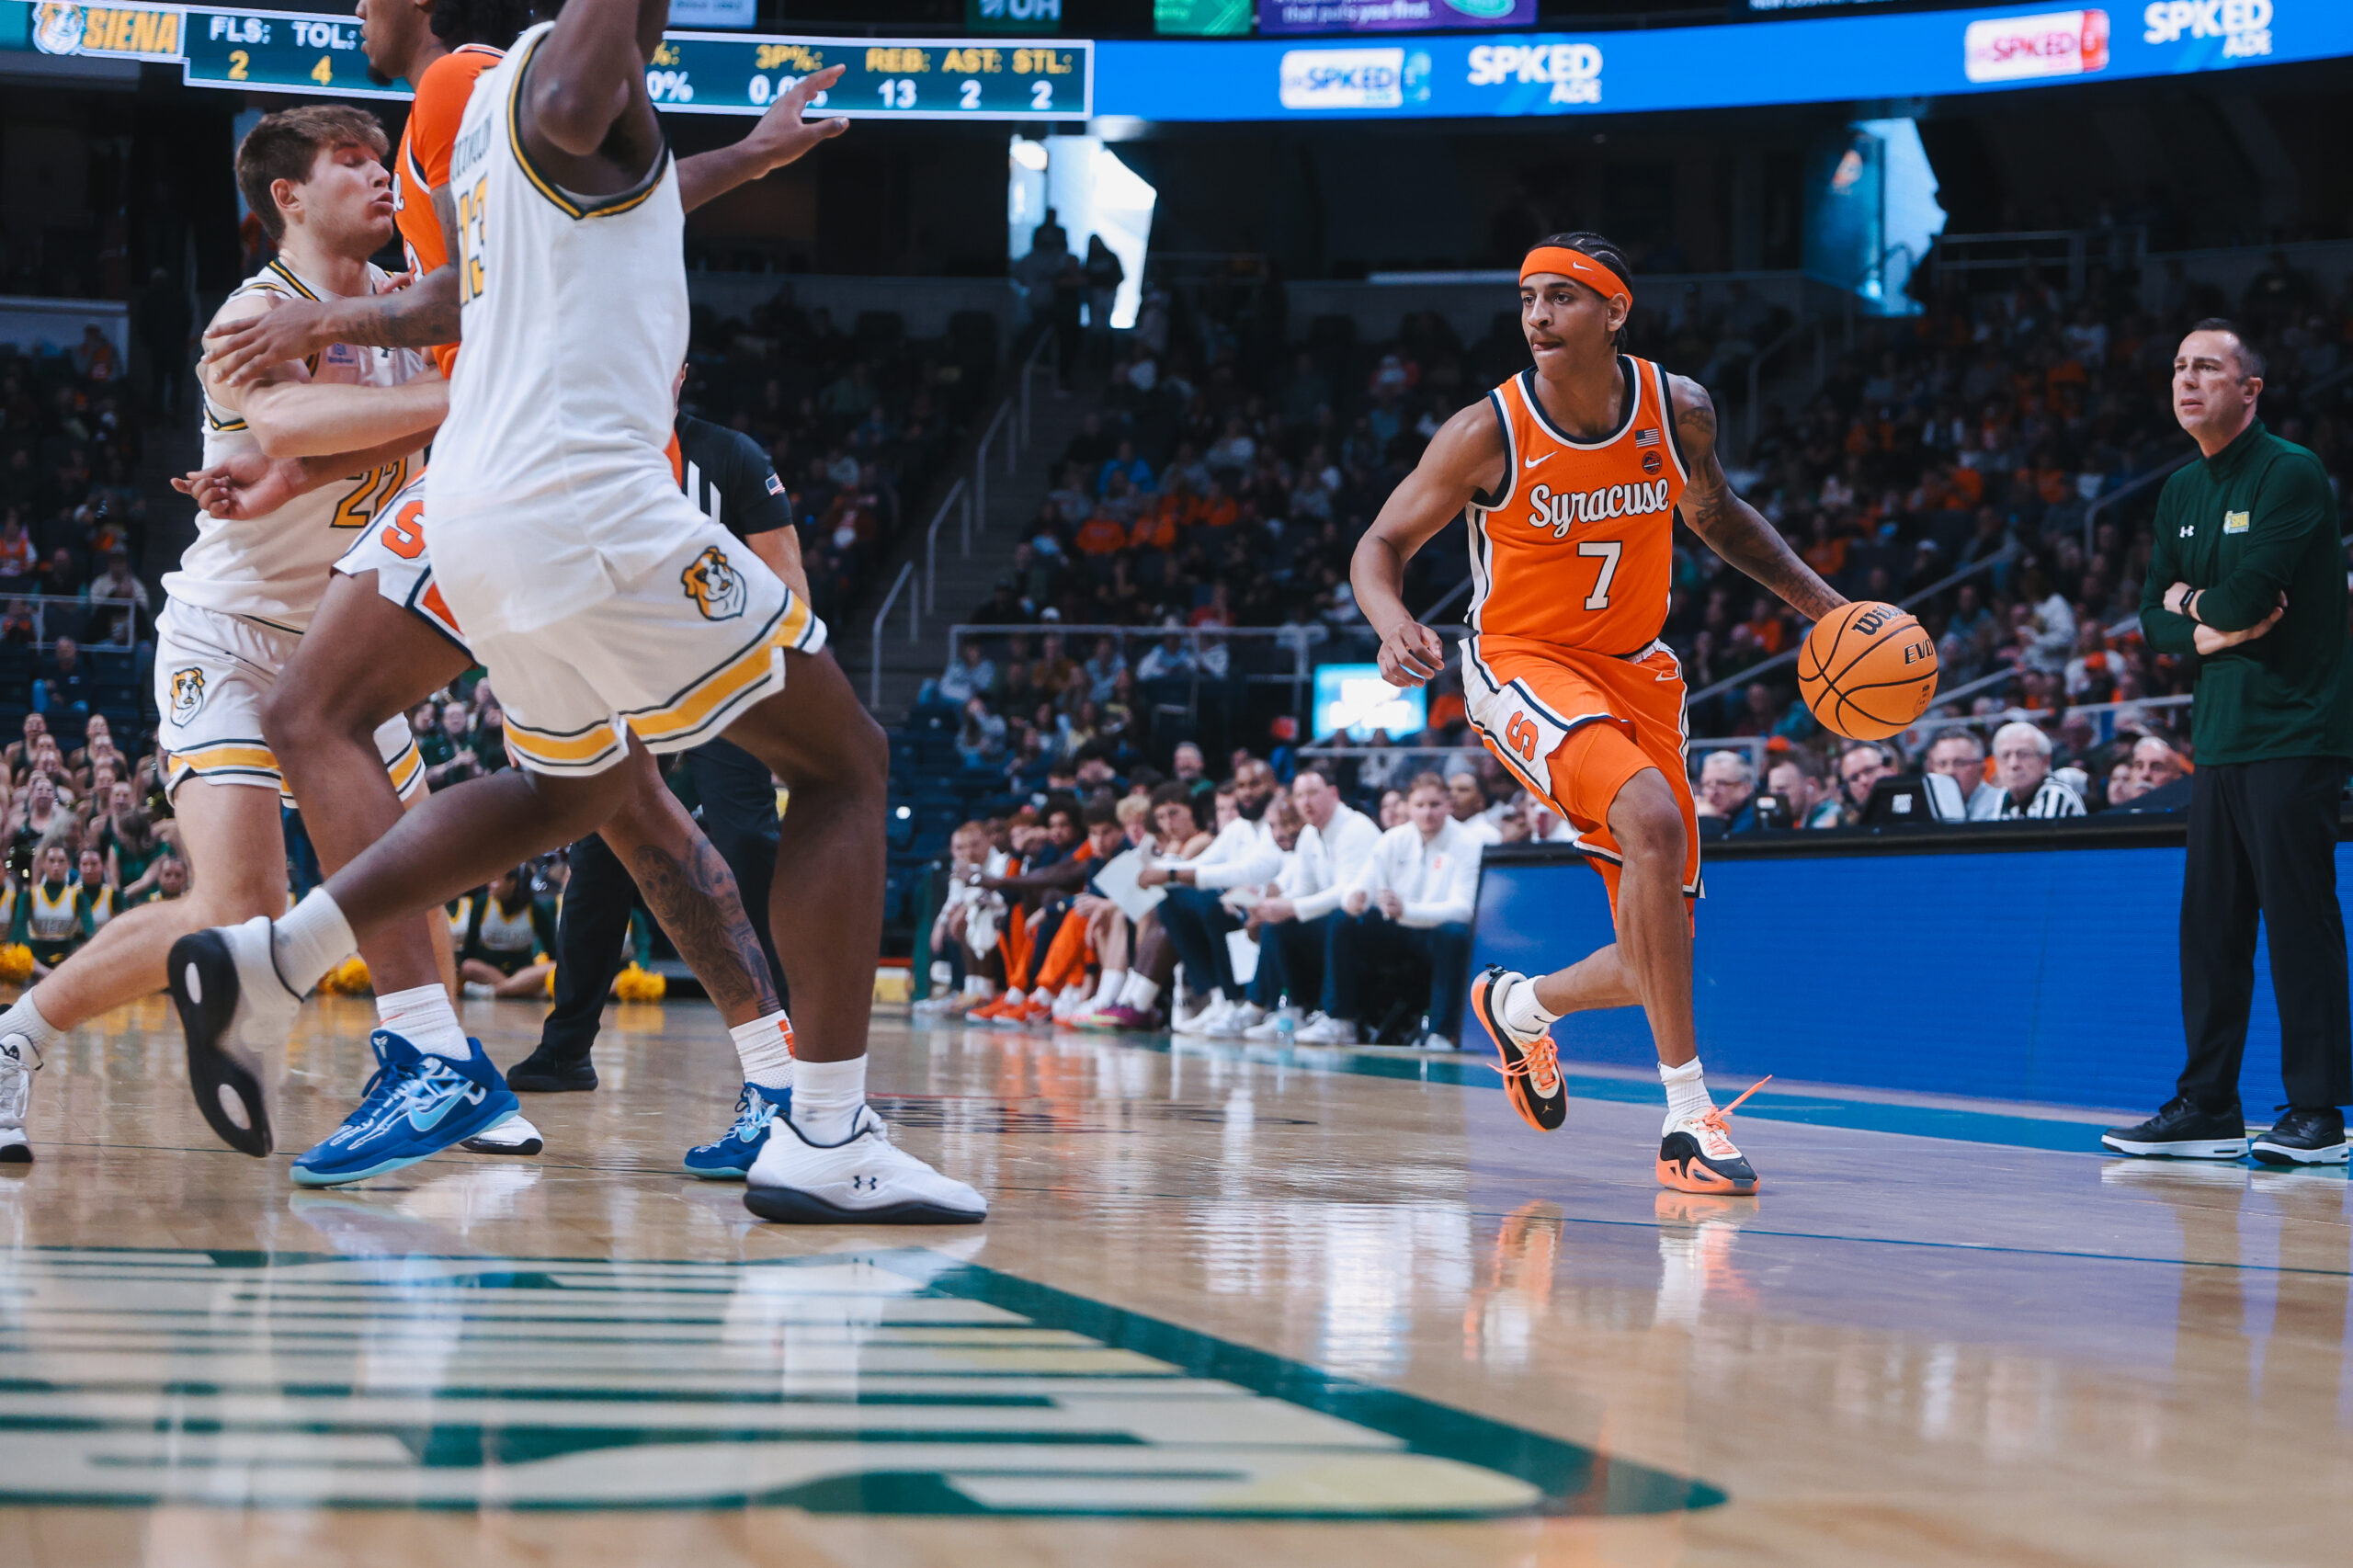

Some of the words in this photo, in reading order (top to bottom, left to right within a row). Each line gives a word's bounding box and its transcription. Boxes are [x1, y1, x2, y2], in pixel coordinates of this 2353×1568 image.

[83, 8, 178, 54] SIENA
[210, 16, 272, 44] FLS:
[291, 21, 357, 50] TOL:
[229, 50, 249, 80] 2
[312, 55, 333, 85] 4
[756, 44, 824, 72] 3P%:
[866, 48, 931, 73] REB:
[941, 48, 1003, 74] AST:
[1012, 48, 1074, 74] STL:
[878, 78, 917, 108] 13
[960, 79, 983, 109] 2
[1030, 80, 1053, 110] 2
[1529, 478, 1669, 539] Syracuse
[381, 500, 426, 559] S
[1577, 540, 1623, 611] 7
[1851, 605, 1905, 636] Wil
[1506, 710, 1539, 762] S
